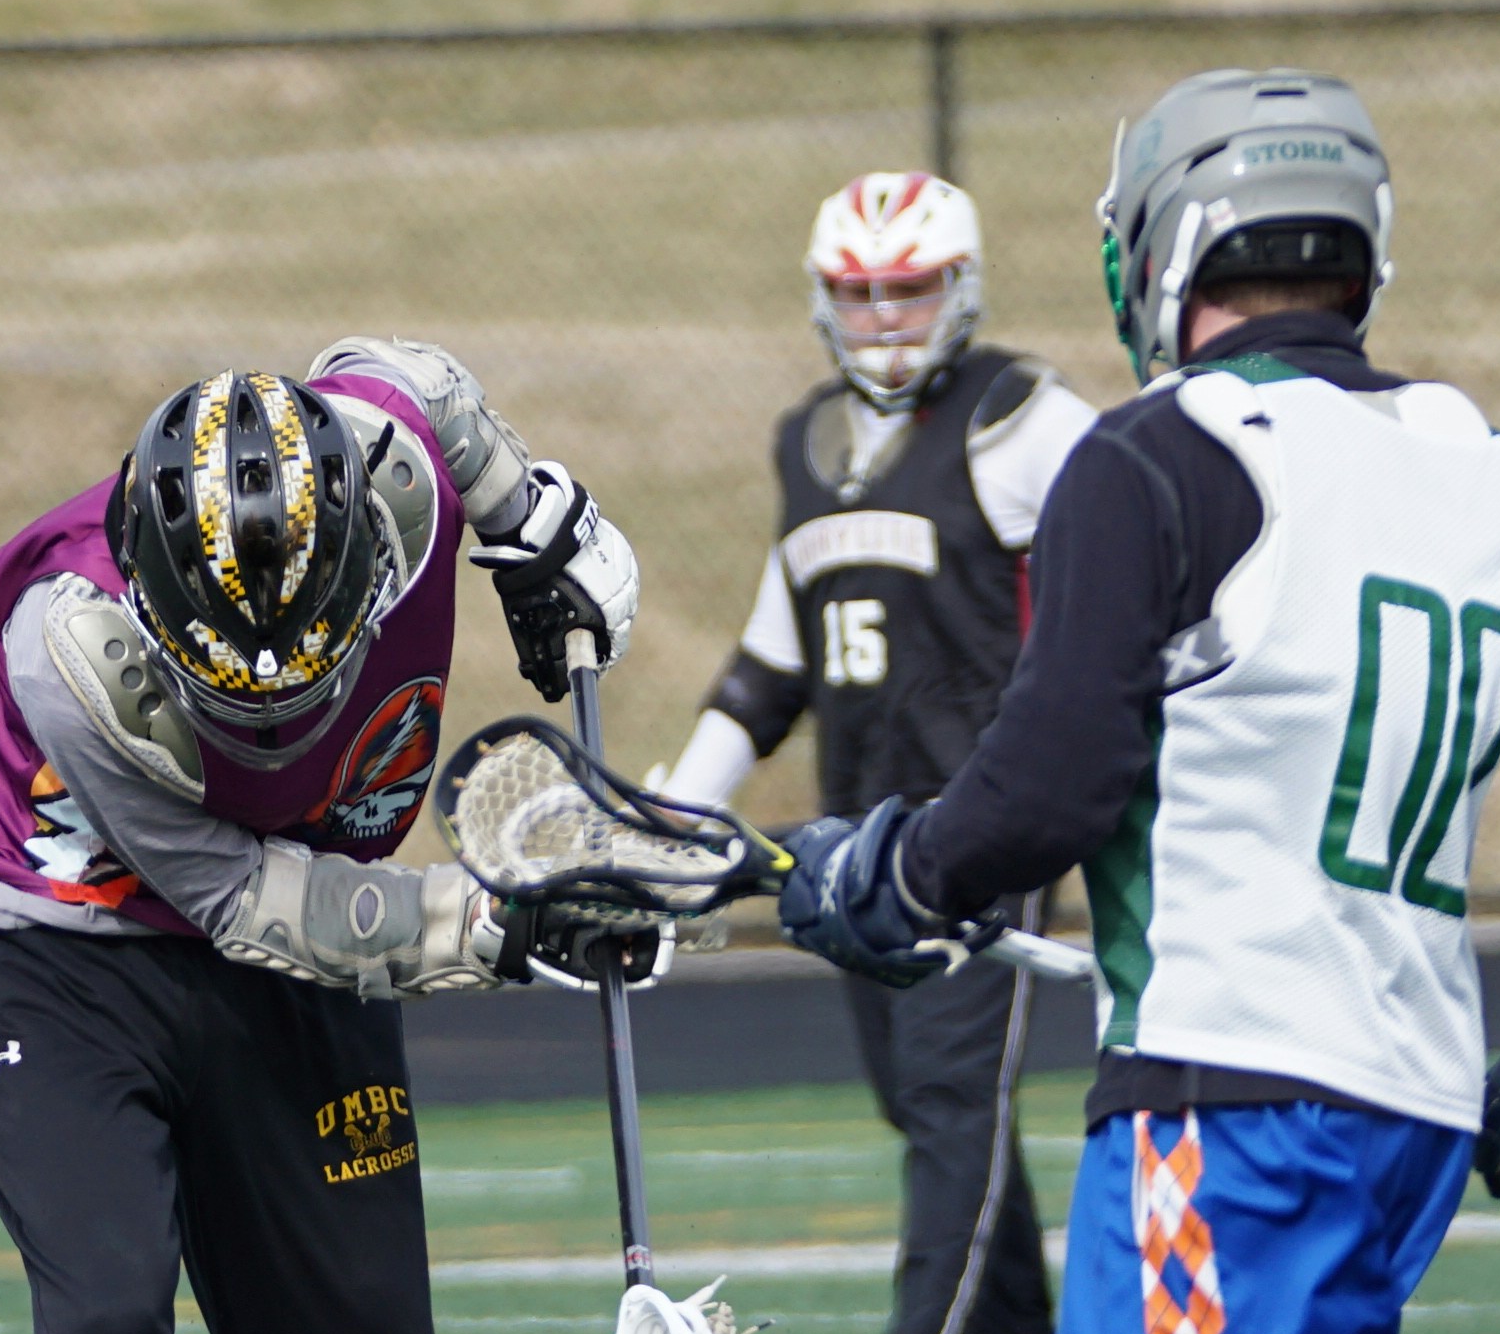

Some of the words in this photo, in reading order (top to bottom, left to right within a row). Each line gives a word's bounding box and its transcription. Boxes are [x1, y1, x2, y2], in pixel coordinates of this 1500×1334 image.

[1242, 140, 1345, 164] STORM
[822, 598, 890, 687] 15
[315, 1085, 409, 1138] UMBC
[323, 1141, 417, 1183] LACROSSE
